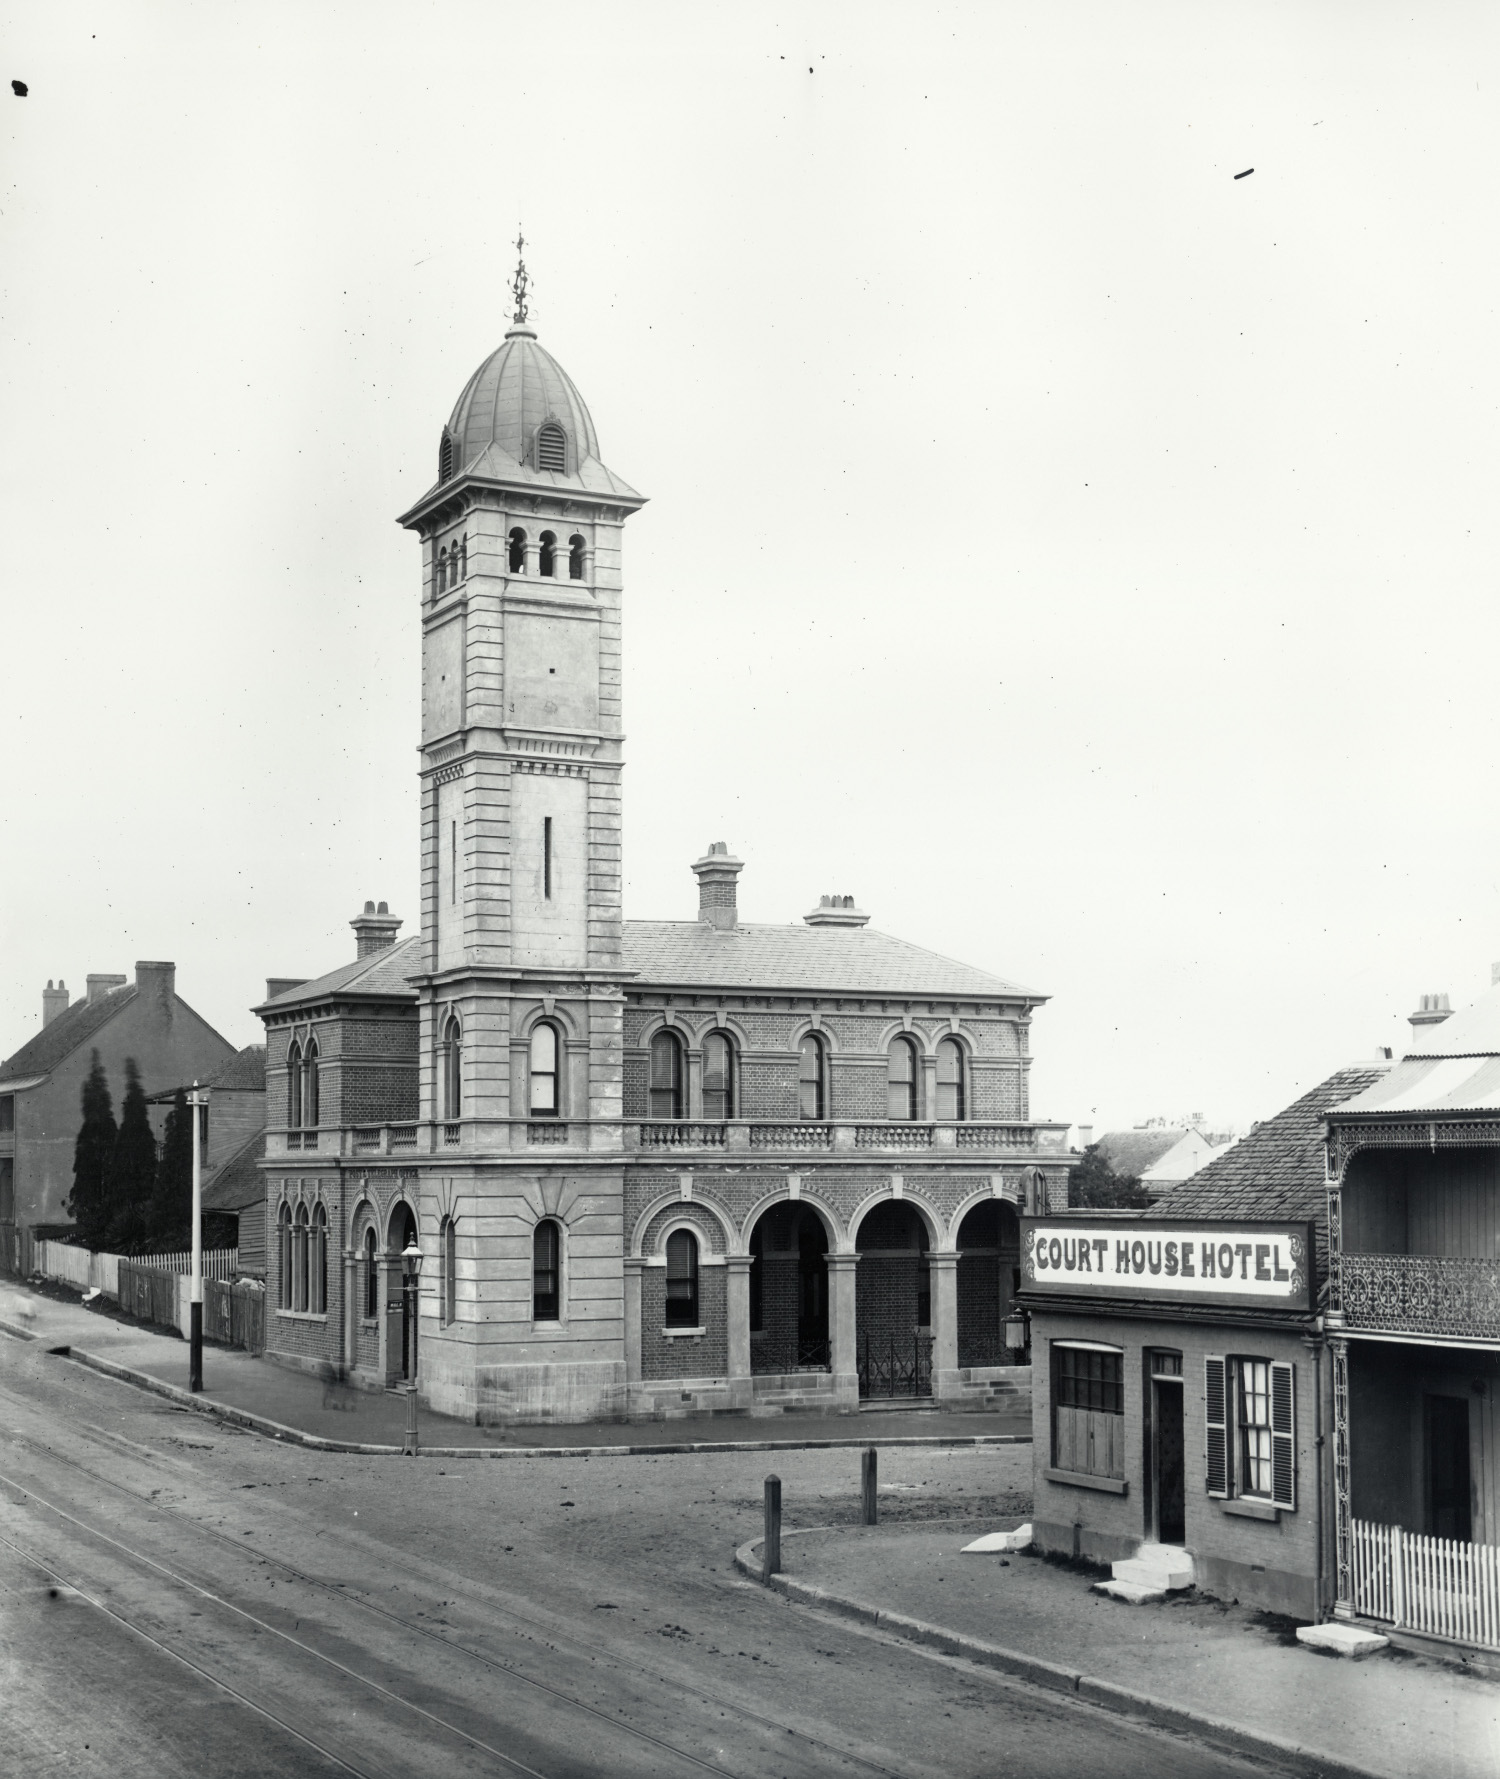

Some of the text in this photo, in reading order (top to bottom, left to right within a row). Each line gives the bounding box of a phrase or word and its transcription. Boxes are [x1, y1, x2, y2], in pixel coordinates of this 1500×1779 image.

[1036, 1237, 1290, 1282] COURT HOUSE HOTEL
